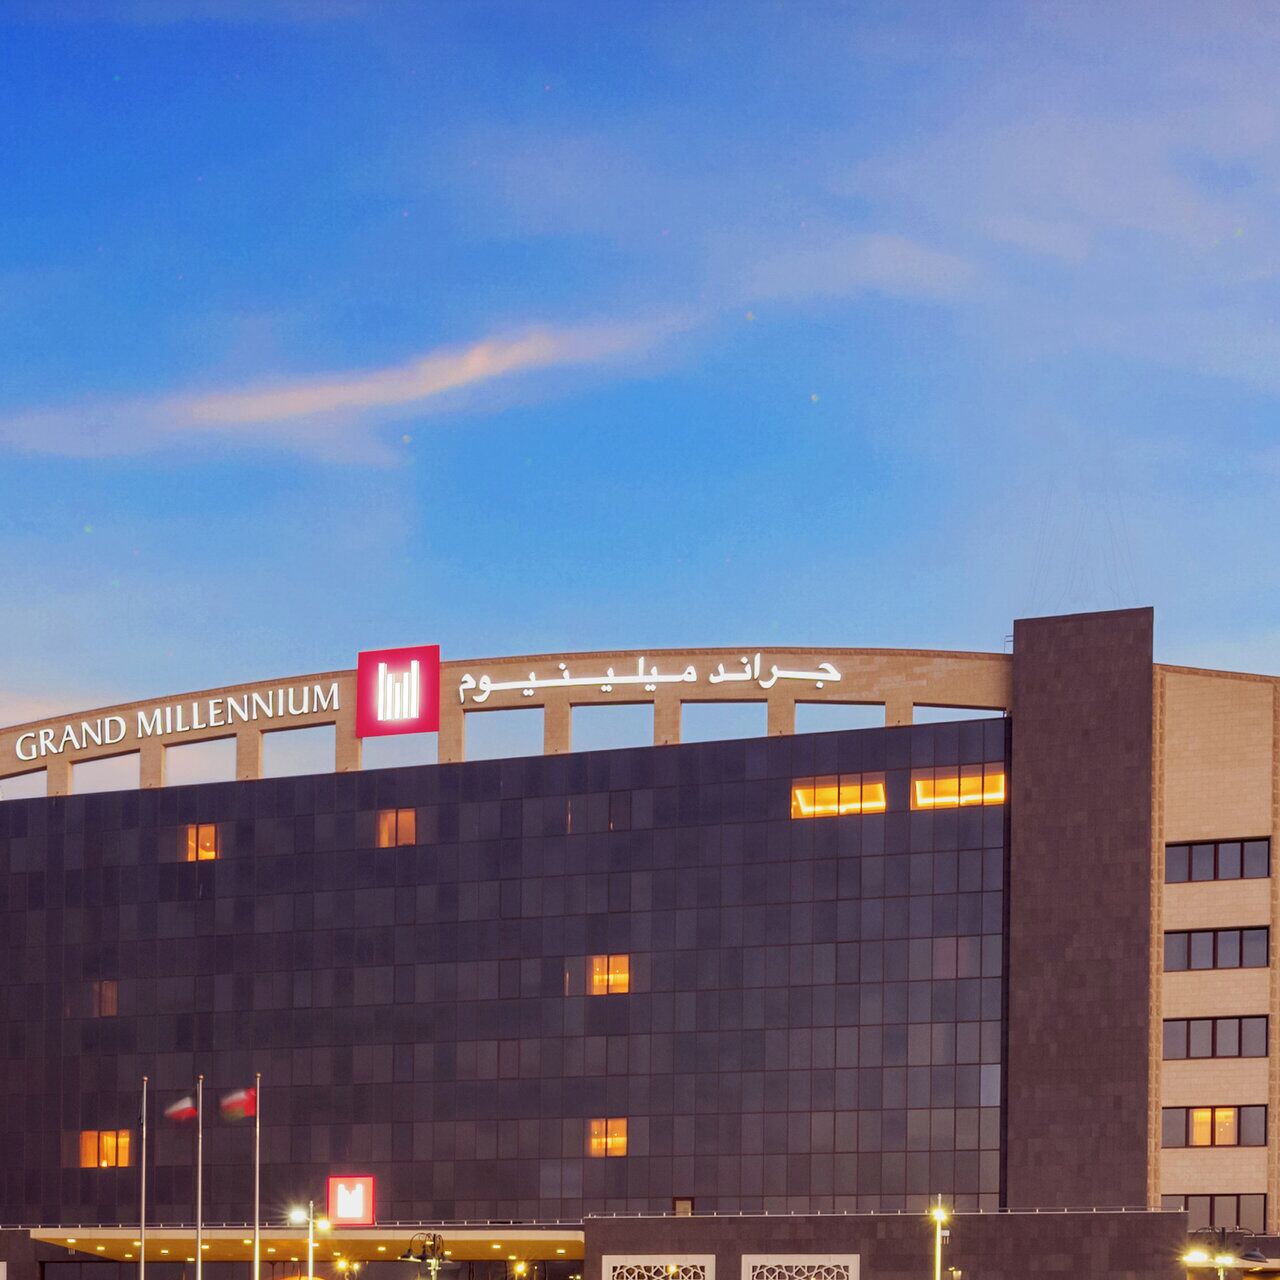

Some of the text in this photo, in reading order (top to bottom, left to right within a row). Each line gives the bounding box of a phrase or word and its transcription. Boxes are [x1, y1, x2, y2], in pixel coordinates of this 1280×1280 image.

[459, 652, 842, 704] جراند ميلينيوم
[15, 682, 340, 761] GRAND MILLENNIUM
